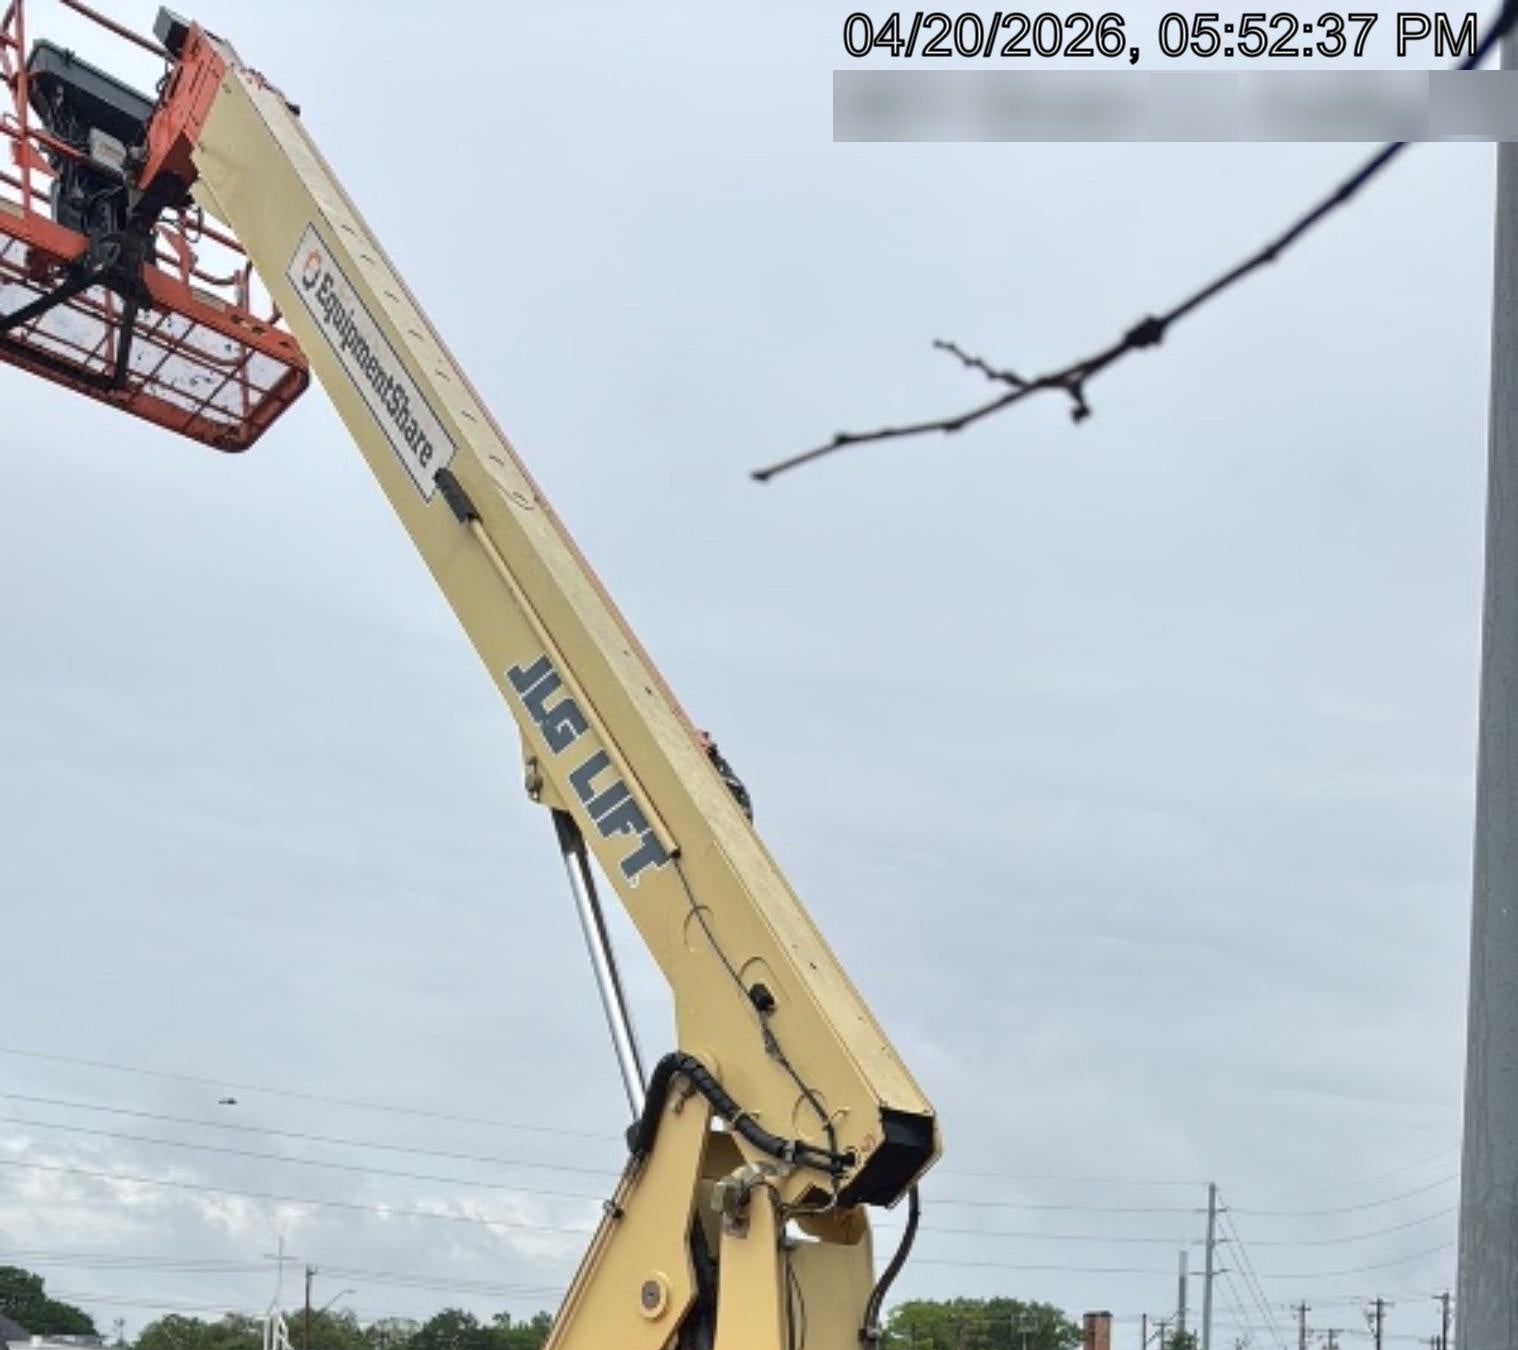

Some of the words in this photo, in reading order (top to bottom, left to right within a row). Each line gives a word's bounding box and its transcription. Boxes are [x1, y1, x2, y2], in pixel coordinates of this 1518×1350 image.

[315, 272, 434, 468] EquipmentShare
[505, 654, 590, 755] JLG
[568, 749, 672, 888] LIFT
